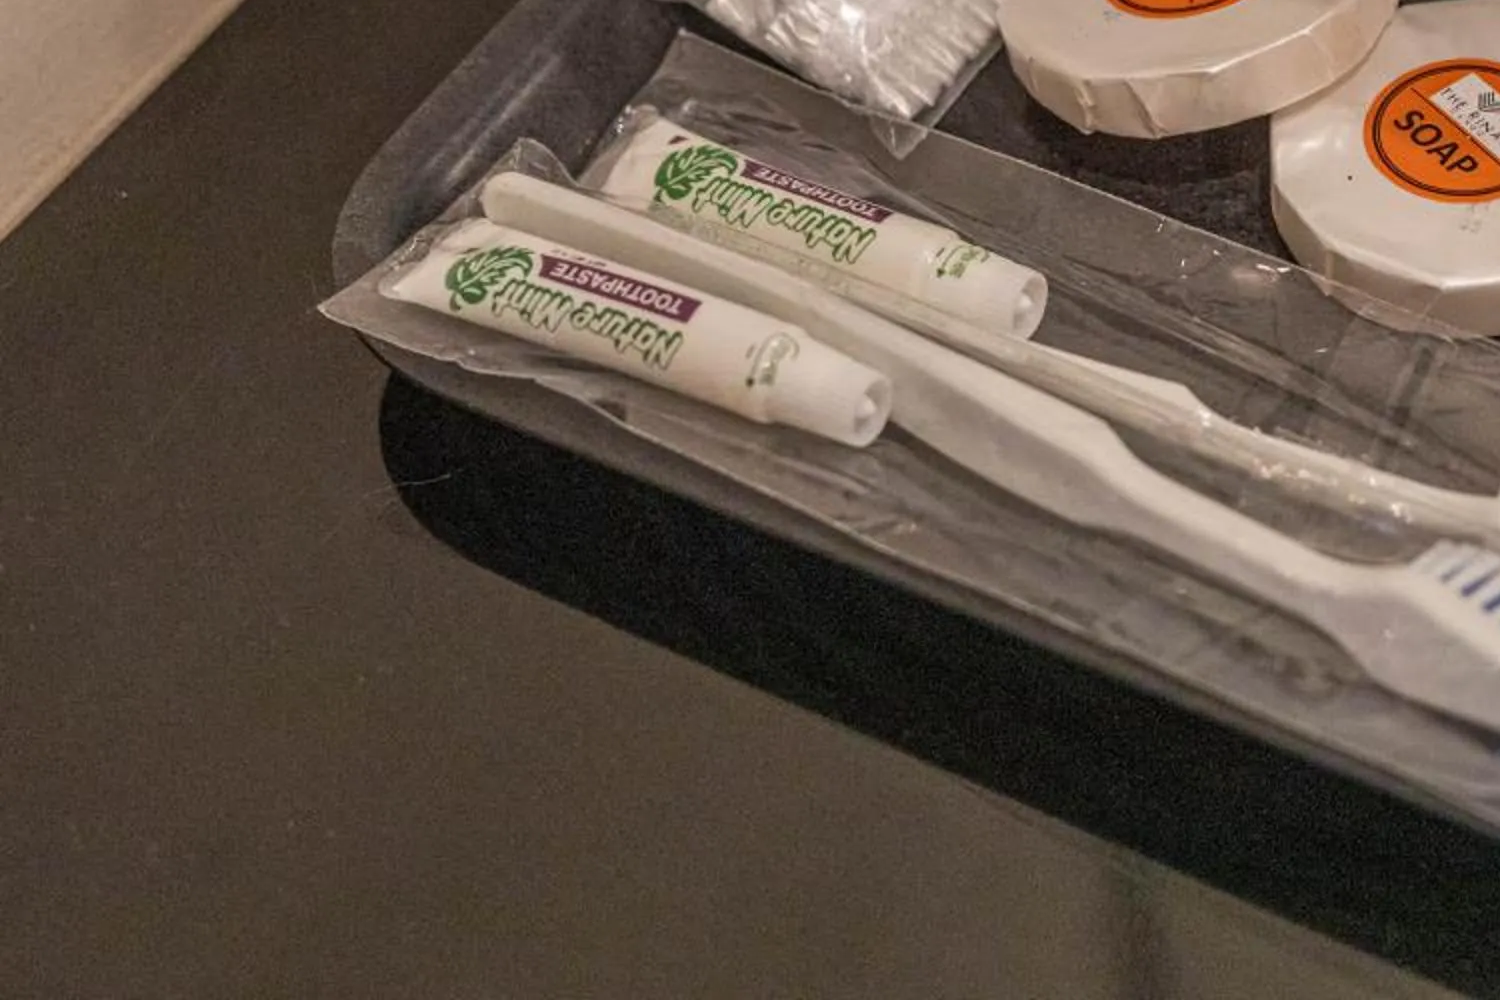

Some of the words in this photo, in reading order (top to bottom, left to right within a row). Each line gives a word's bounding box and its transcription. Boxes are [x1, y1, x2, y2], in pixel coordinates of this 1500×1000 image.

[1394, 110, 1479, 173] SOAP
[692, 175, 772, 229] Mint
[756, 166, 880, 219] TOOTHPASTE
[768, 198, 878, 264] Nature
[493, 277, 568, 333] Mint
[549, 261, 683, 315] TOOTHPASTE
[570, 306, 683, 371] Nature
